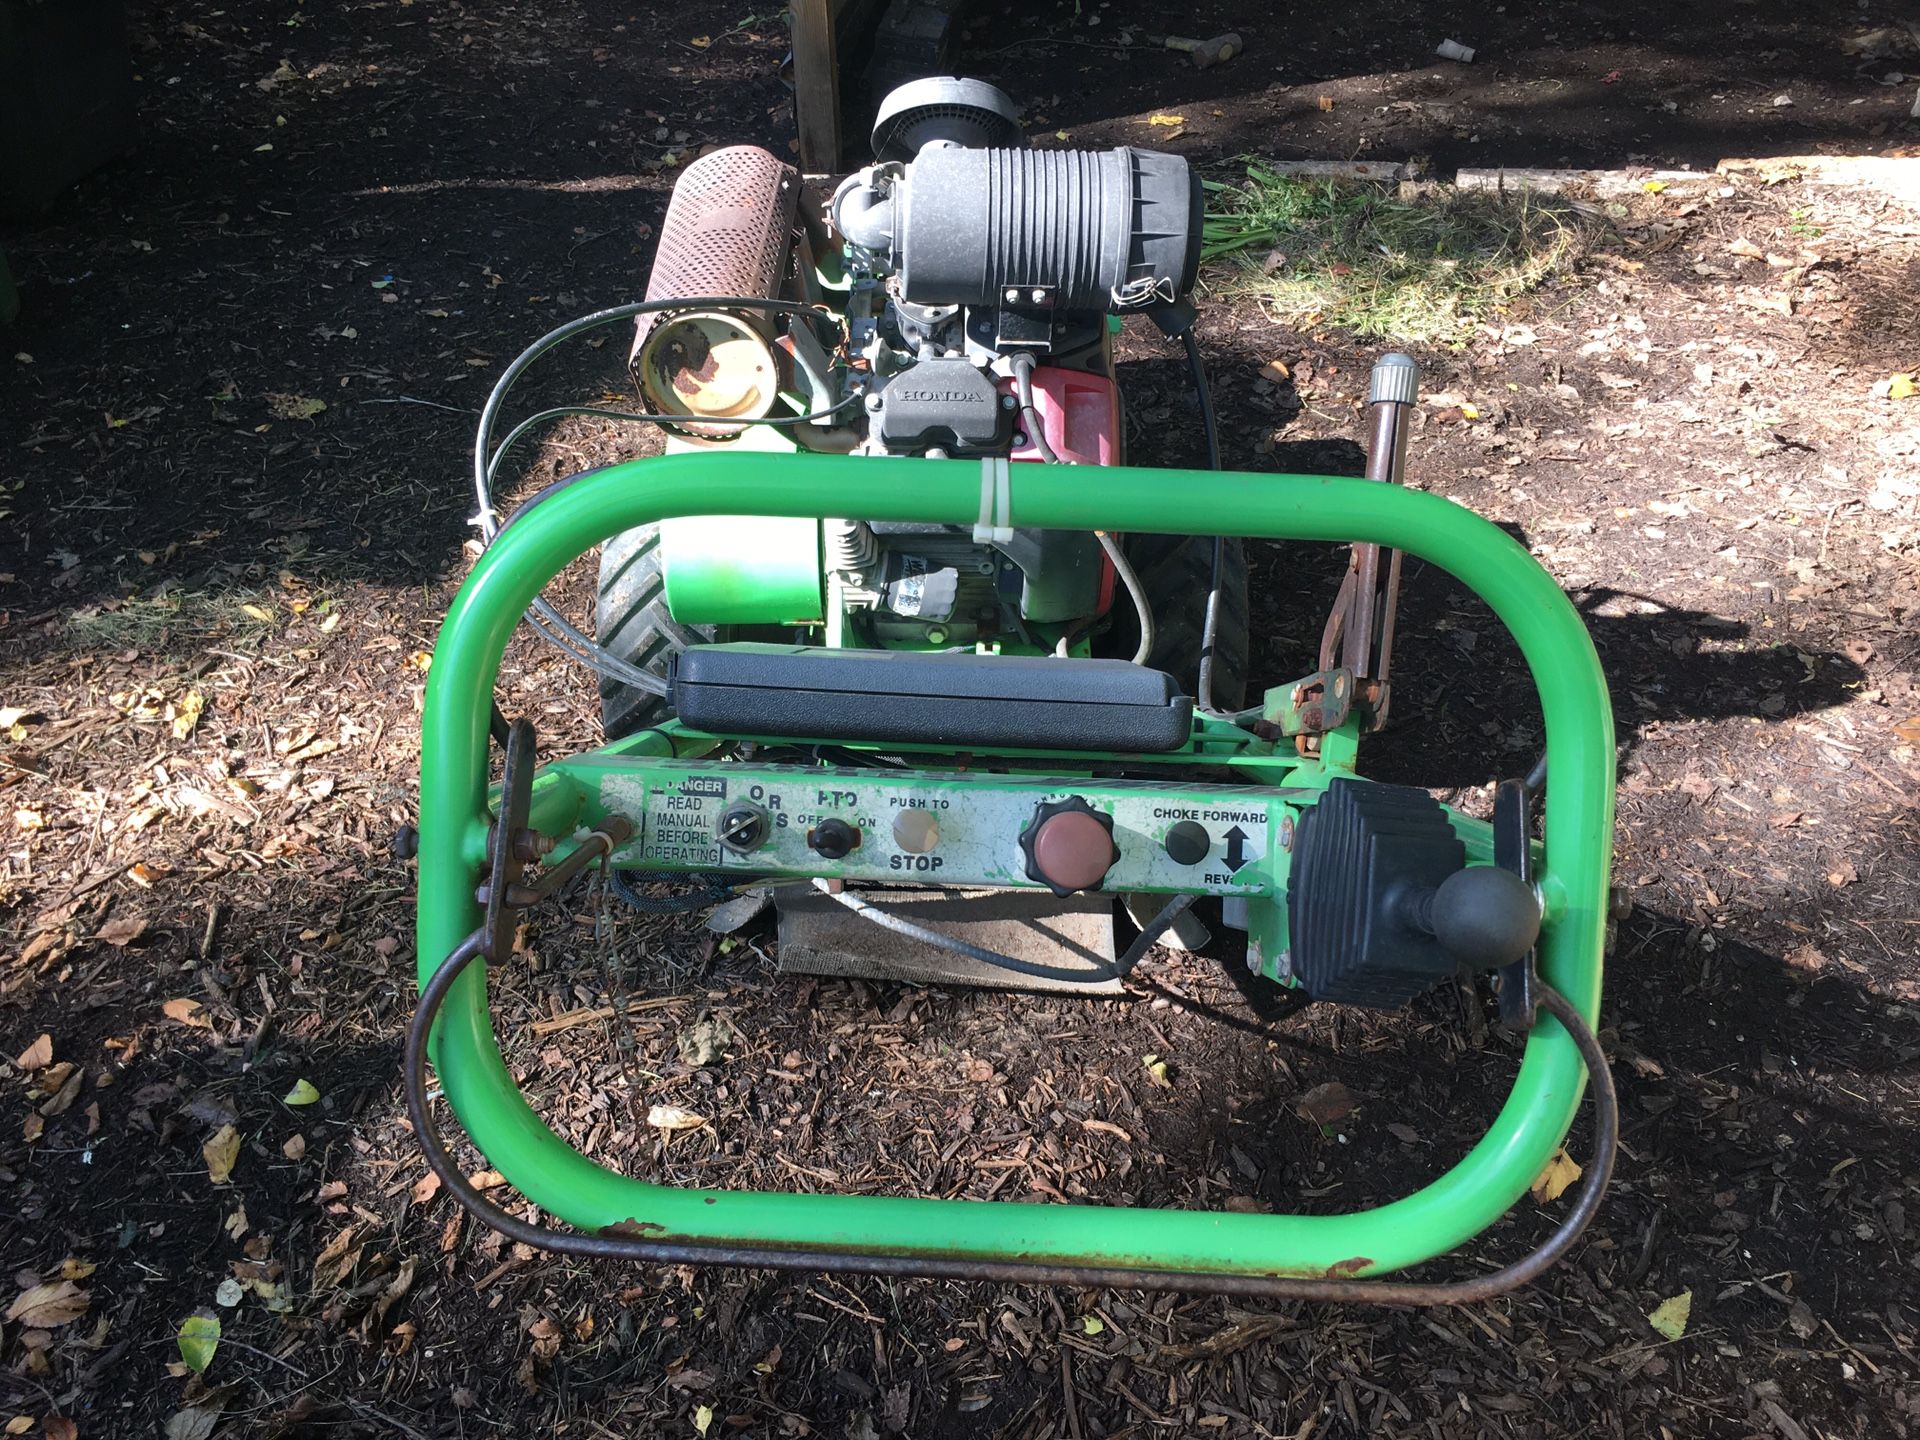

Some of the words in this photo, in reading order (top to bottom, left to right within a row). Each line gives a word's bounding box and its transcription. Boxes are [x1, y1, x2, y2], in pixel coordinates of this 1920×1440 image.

[900, 389, 984, 403] HONDA
[667, 796, 702, 810] READ
[890, 797, 926, 808] PUSH
[932, 800, 950, 809] TO
[657, 812, 710, 828] MANUAL
[1153, 808, 1199, 820] CHOKE
[1203, 811, 1268, 824] FORWARD
[857, 817, 876, 827] ON
[657, 829, 708, 844] BEFORE
[645, 845, 718, 862] OPERATING
[890, 855, 943, 871] STOP
